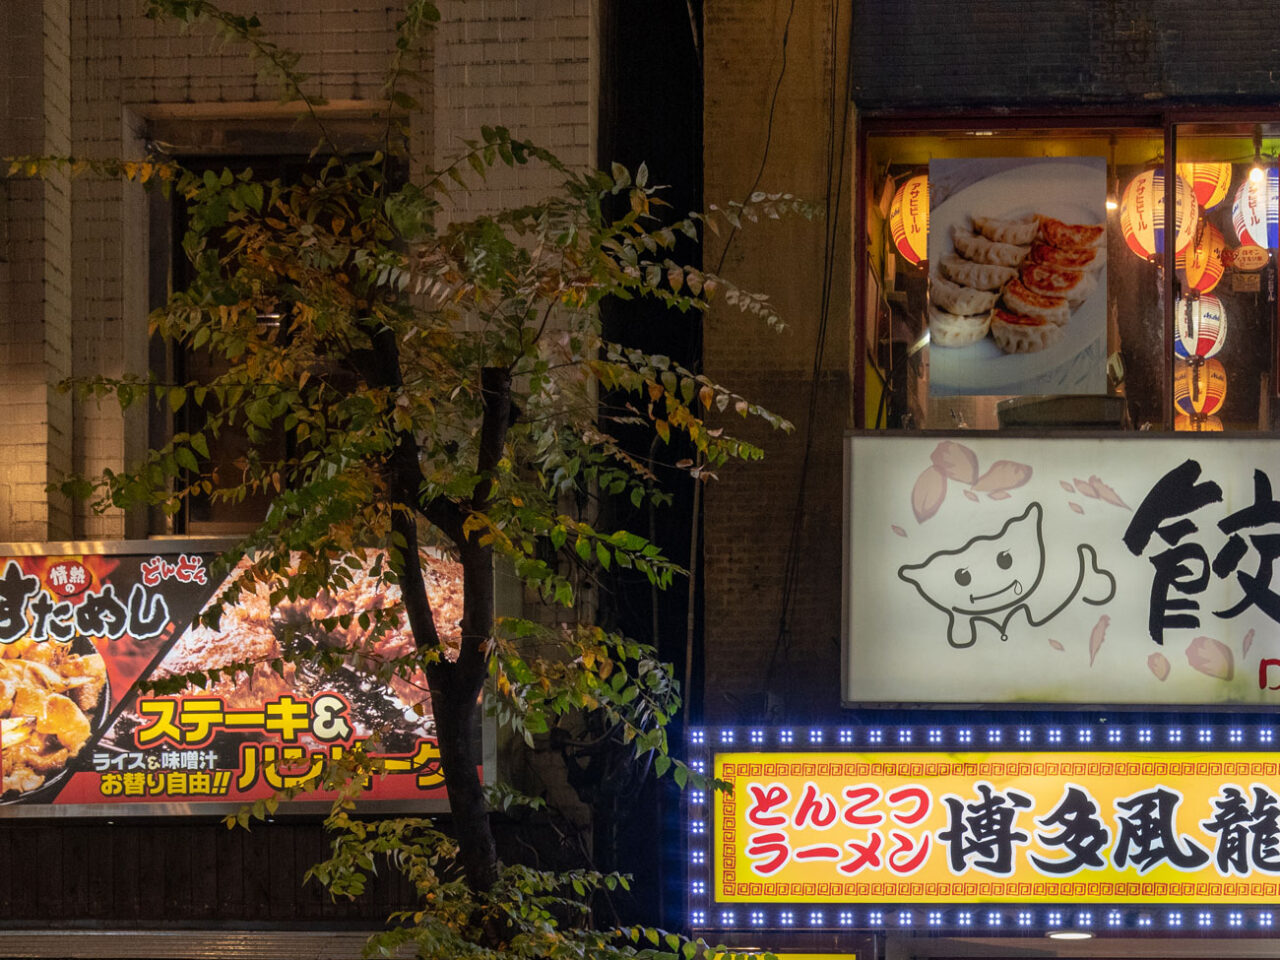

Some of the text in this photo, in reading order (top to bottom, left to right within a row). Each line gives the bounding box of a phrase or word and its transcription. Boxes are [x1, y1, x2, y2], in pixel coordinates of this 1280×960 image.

[747, 784, 930, 828] とんこつ
[747, 831, 930, 875] ラーメン
